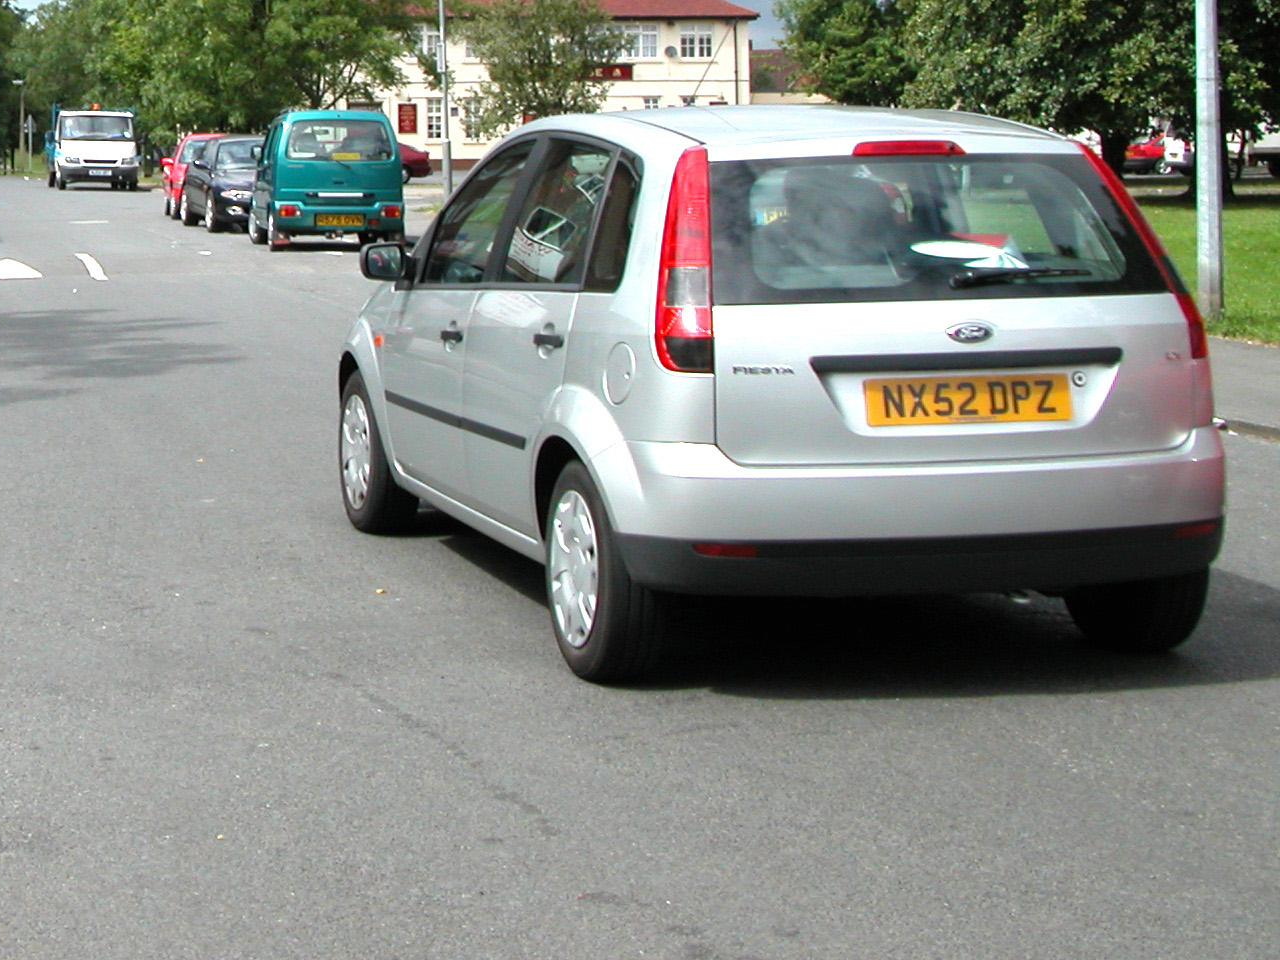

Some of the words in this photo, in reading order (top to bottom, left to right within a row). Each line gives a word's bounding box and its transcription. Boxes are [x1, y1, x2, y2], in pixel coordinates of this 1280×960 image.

[732, 366, 796, 376] FIESTA
[882, 382, 979, 419] NX52
[987, 380, 1057, 415] DPZ
